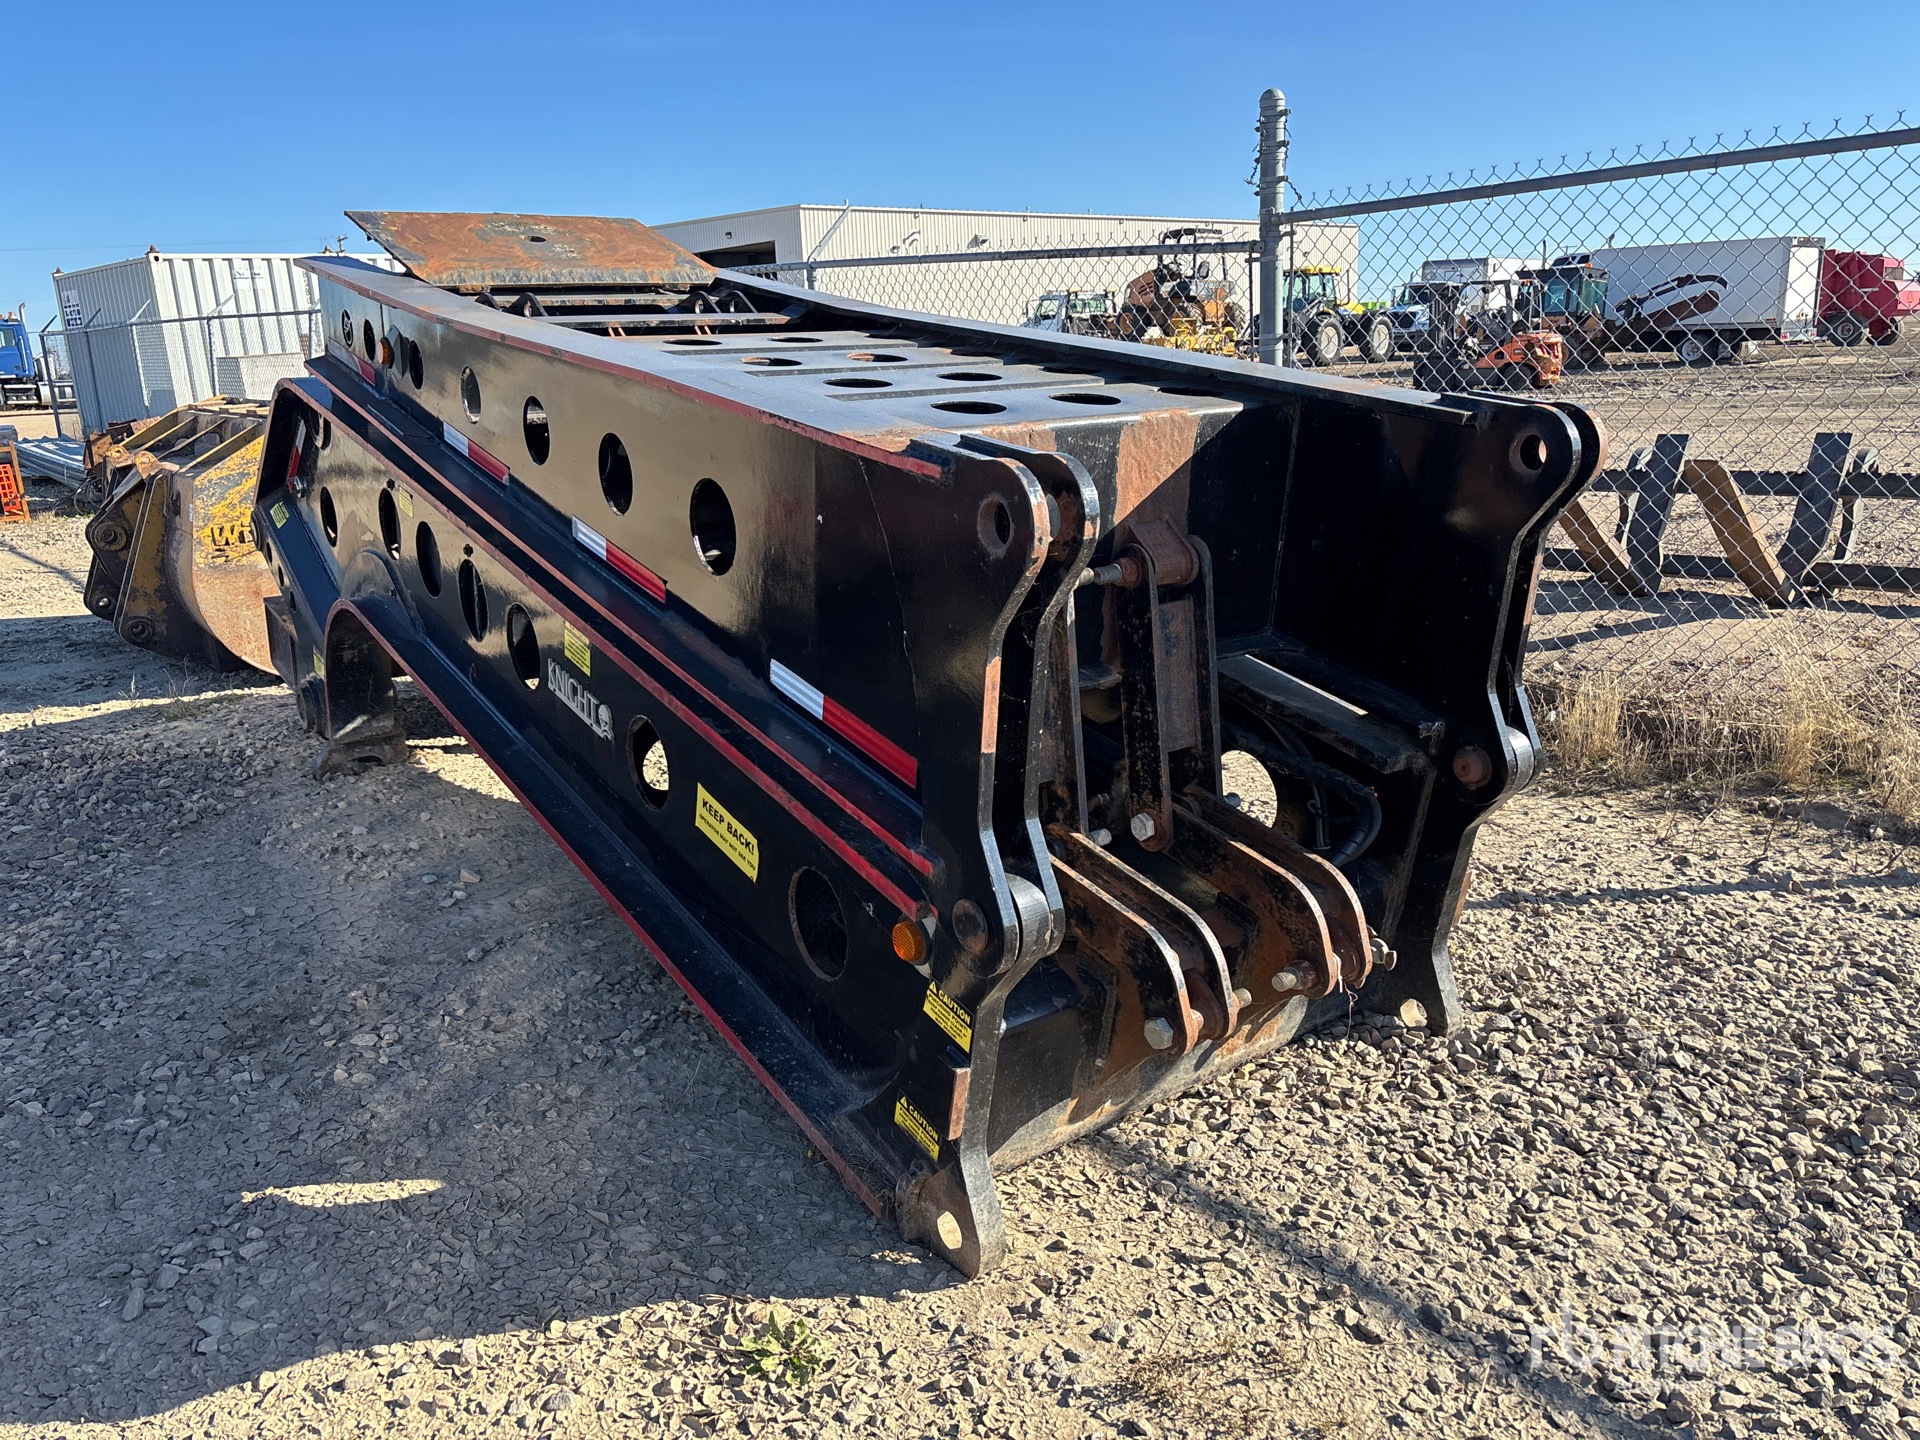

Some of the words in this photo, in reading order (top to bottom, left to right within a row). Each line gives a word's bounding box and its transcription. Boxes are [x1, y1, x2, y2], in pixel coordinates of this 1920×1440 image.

[548, 658, 601, 722] KNIGHT
[702, 797, 725, 825] KEEP
[727, 821, 754, 855] BACK!
[938, 990, 970, 1025] CAUTION
[909, 1105, 938, 1142] CAUTION
